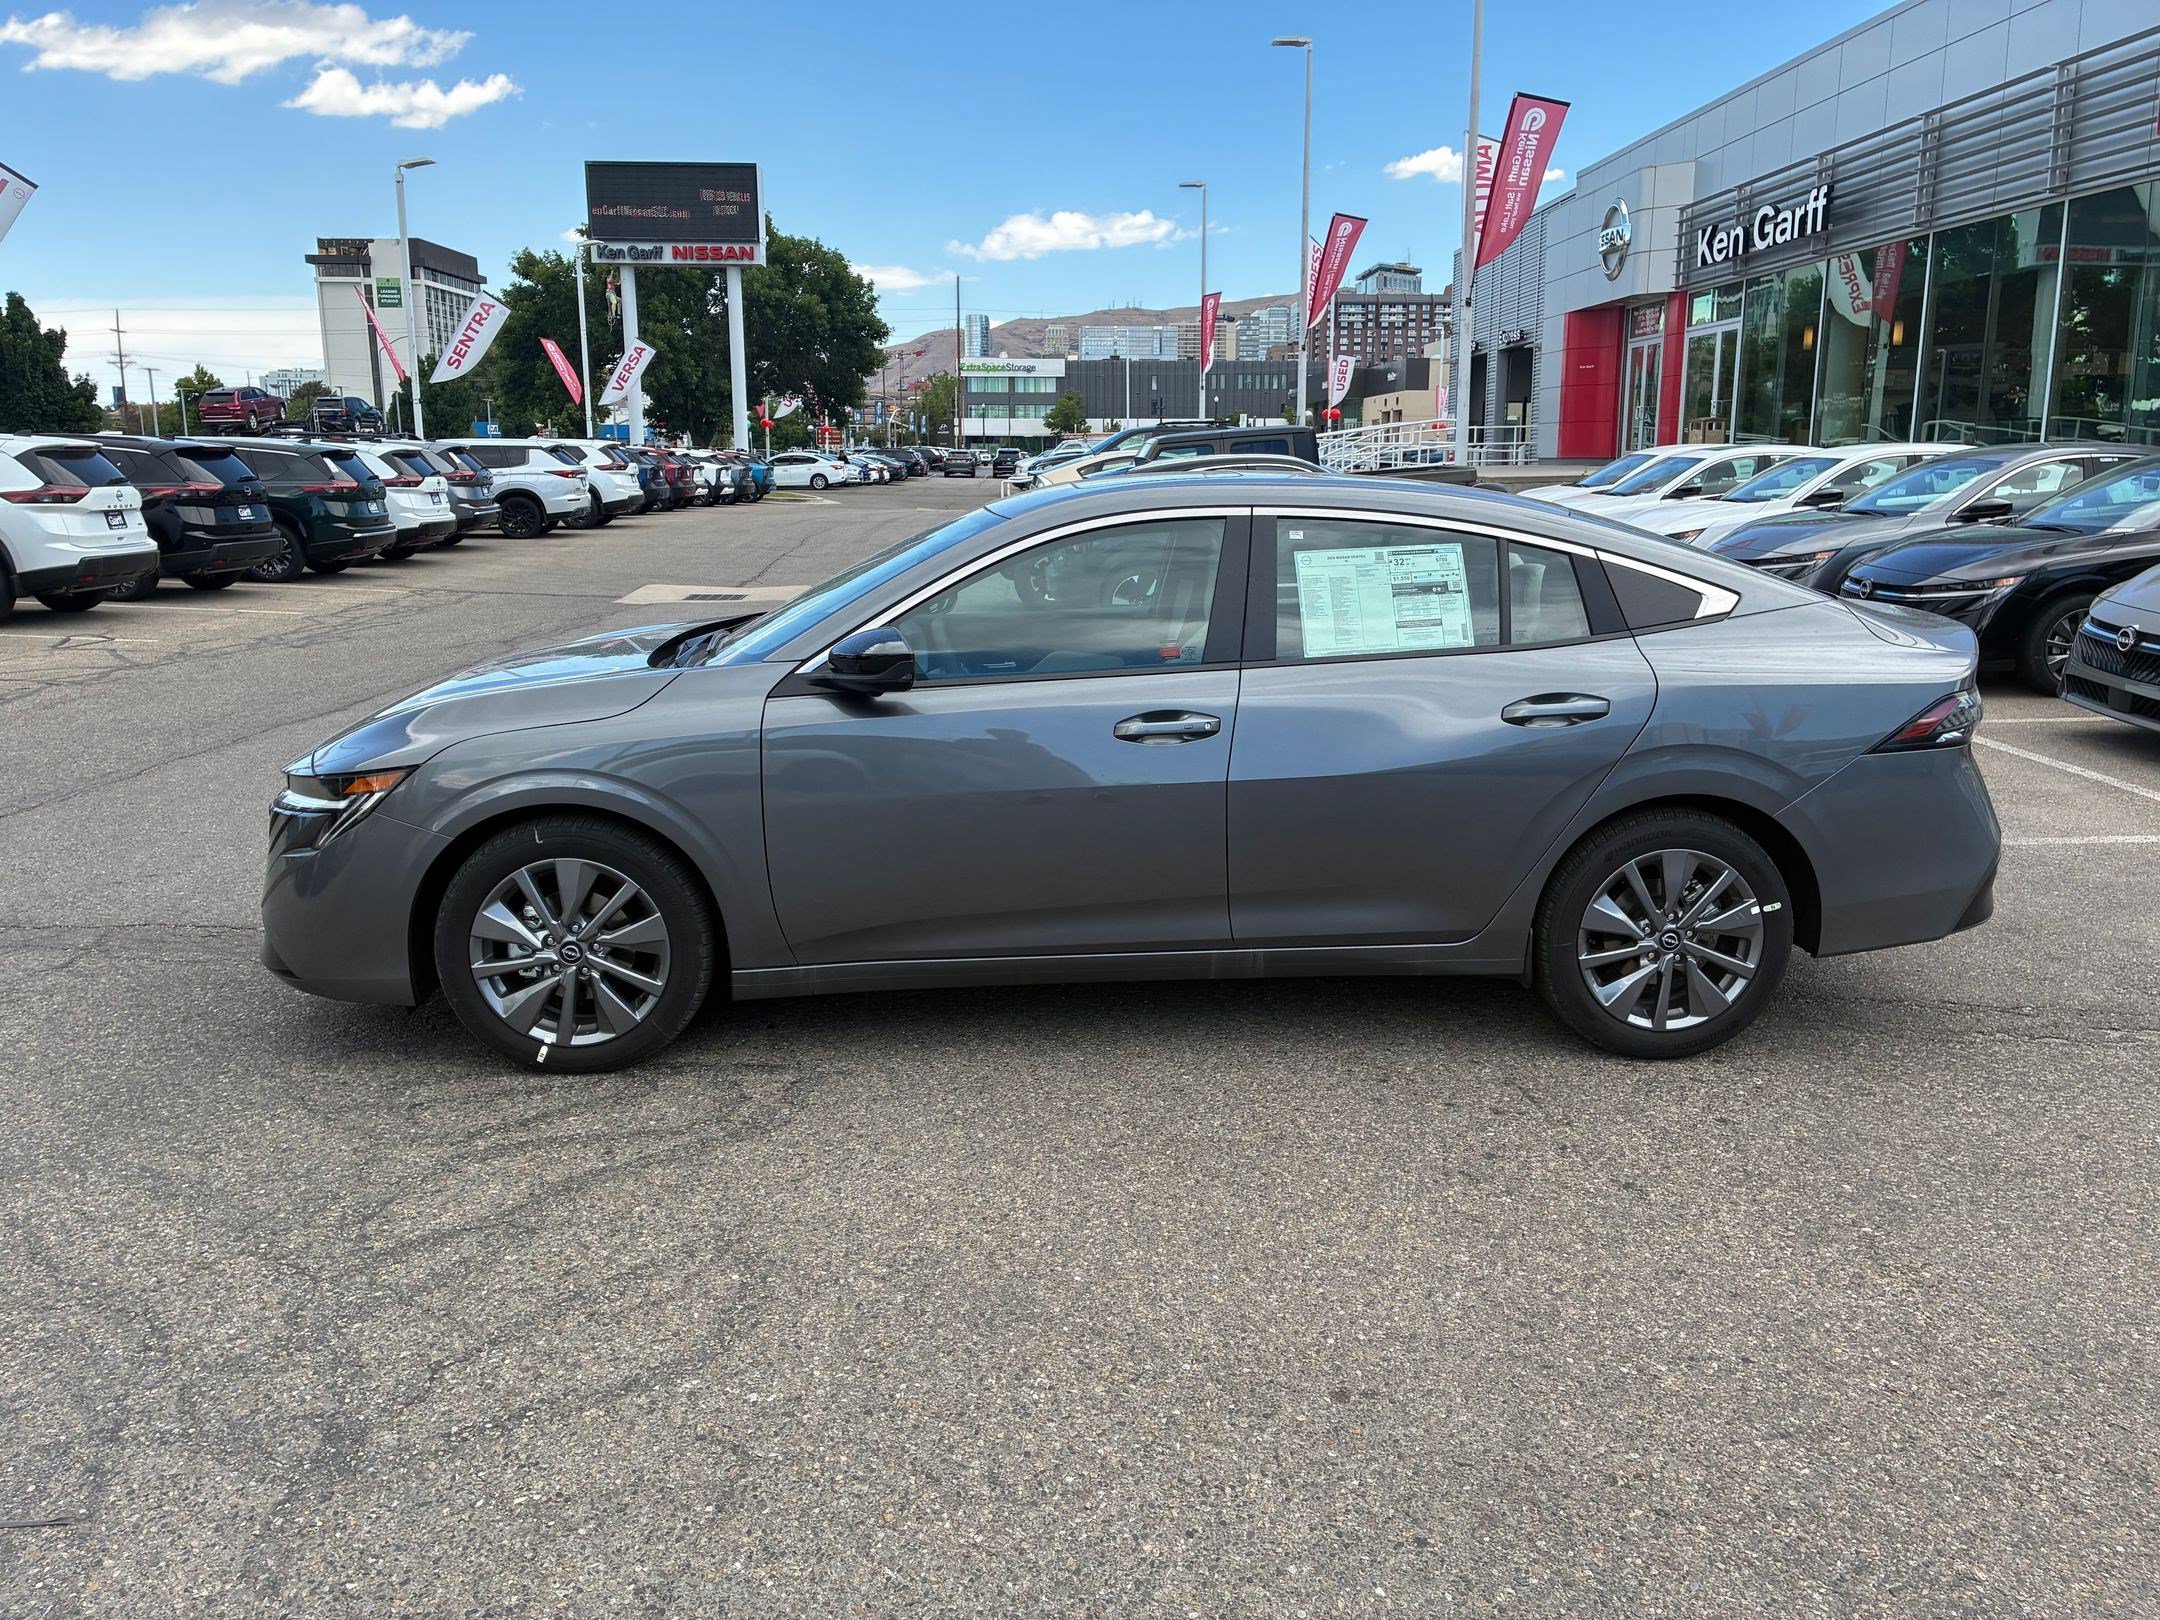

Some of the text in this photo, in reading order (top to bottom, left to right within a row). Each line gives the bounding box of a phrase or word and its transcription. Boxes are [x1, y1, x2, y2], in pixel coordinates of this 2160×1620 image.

[1697, 185, 1830, 267] Ken Garff
[596, 244, 754, 261] Ken Garff NISSAN
[447, 302, 496, 370] SENTRA
[612, 346, 646, 392] VERSA
[1336, 359, 1349, 391] USED
[1393, 558, 1405, 566] 32
